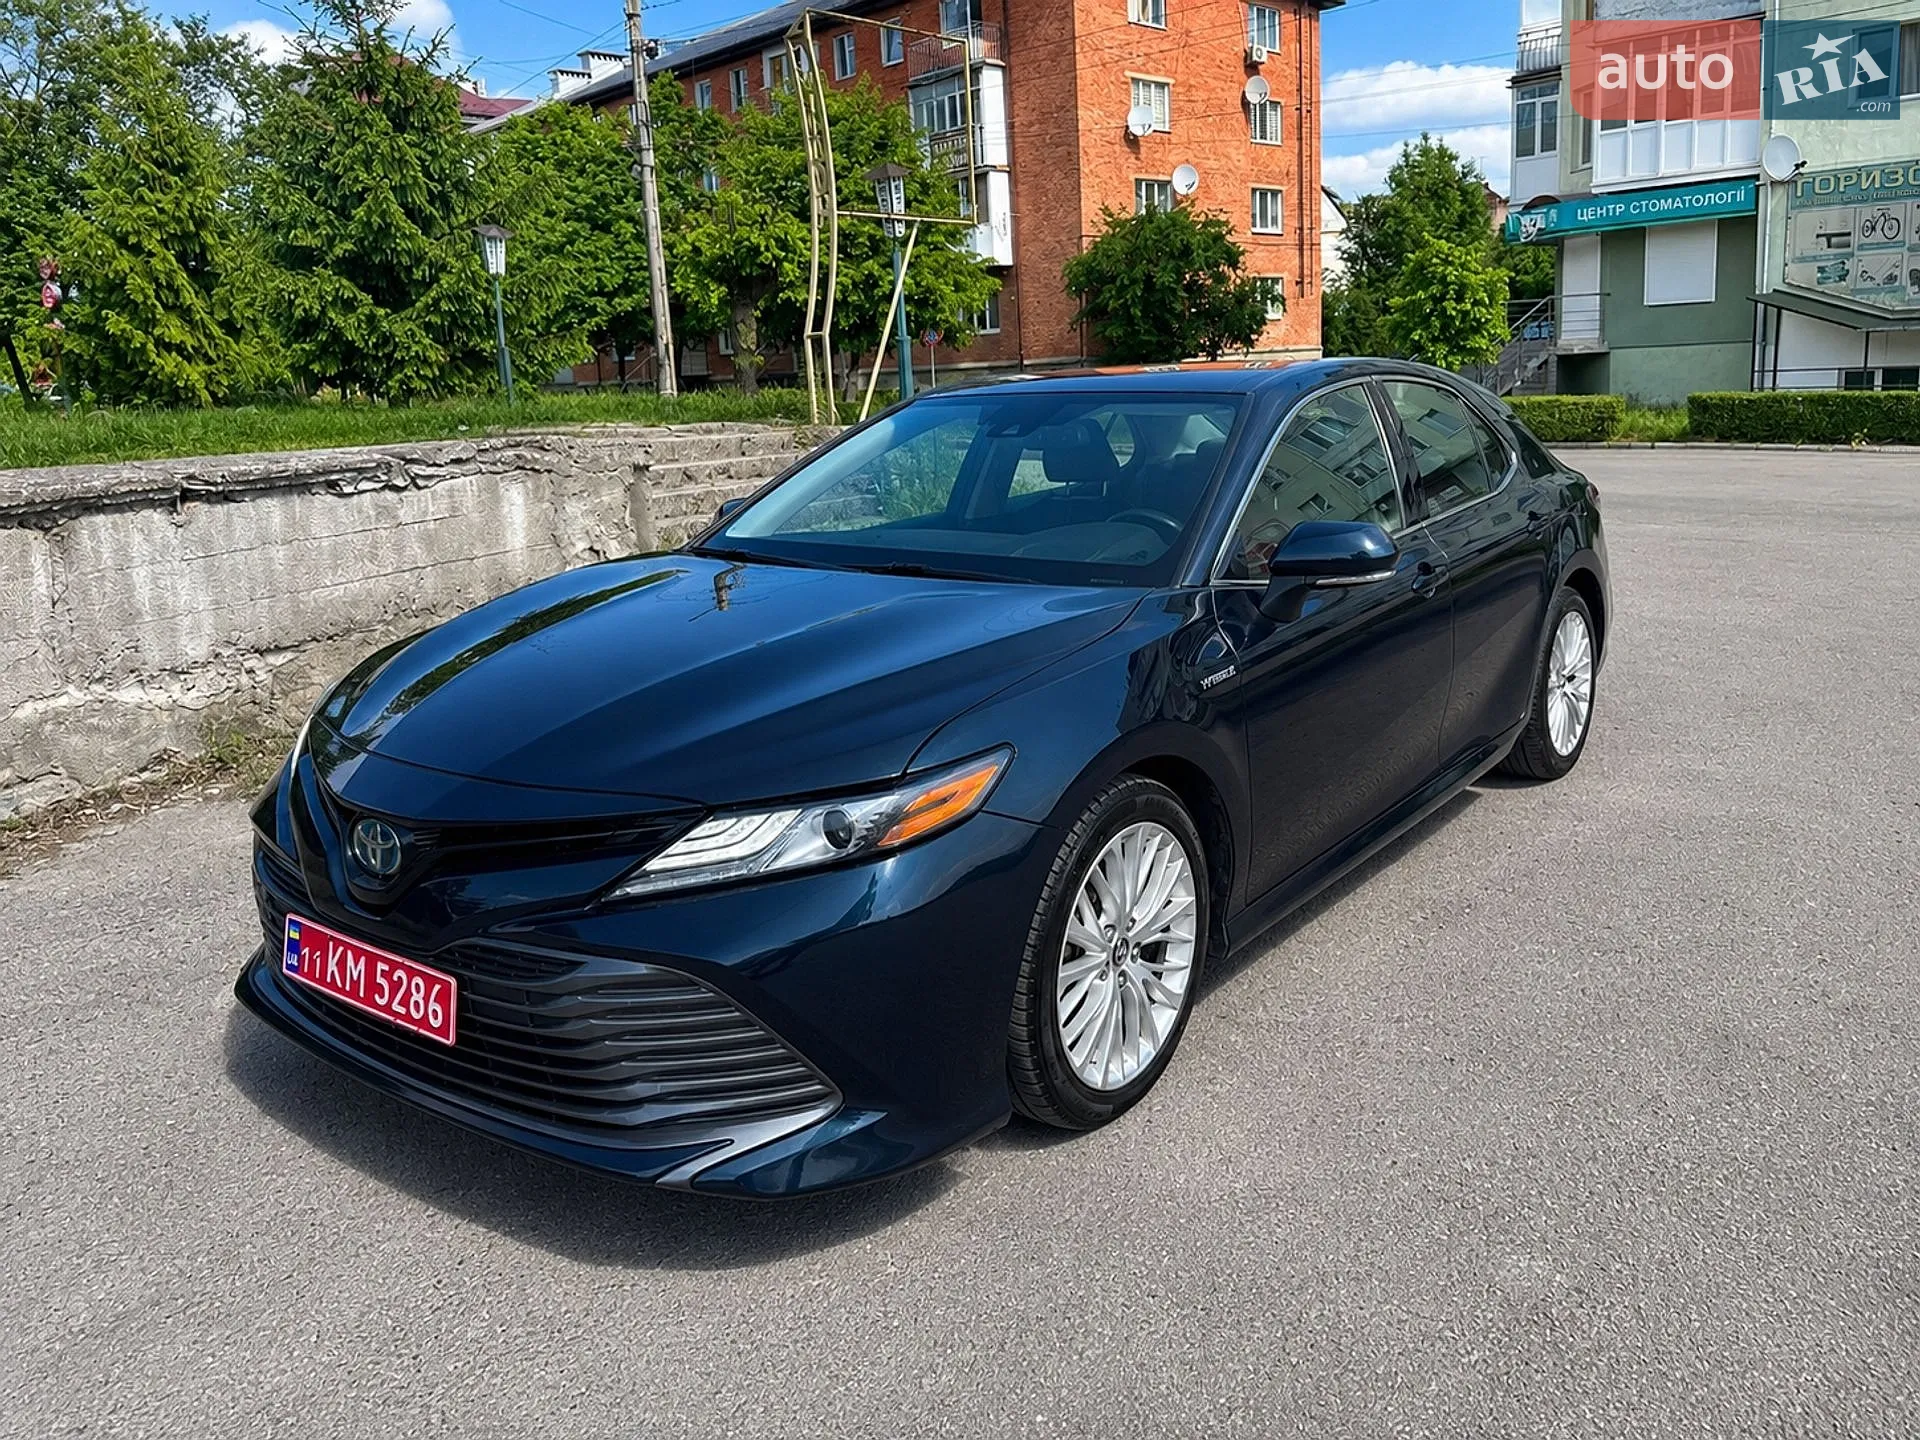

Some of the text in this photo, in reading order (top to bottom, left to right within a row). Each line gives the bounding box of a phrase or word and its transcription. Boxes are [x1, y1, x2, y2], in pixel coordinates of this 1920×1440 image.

[1577, 186, 1745, 221] ЦЕНТР СТОМАТОЛОГІЇ
[374, 961, 443, 1029] 5286
